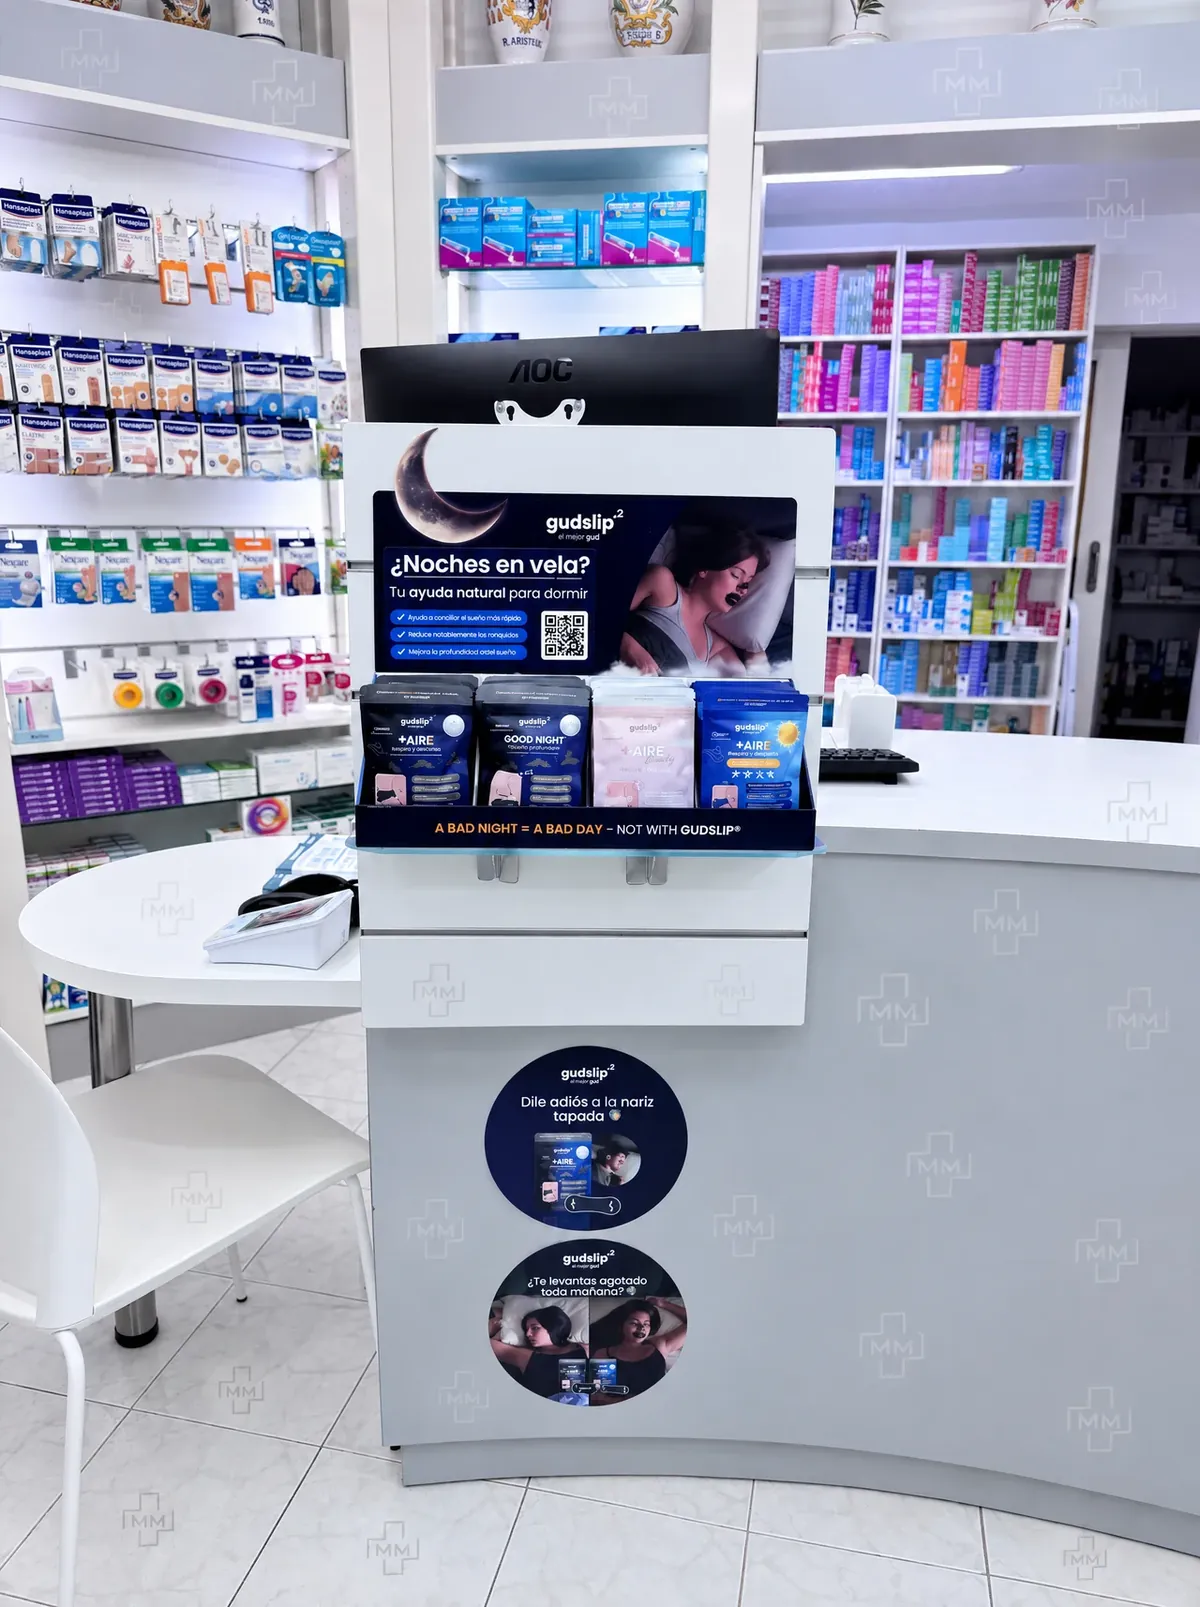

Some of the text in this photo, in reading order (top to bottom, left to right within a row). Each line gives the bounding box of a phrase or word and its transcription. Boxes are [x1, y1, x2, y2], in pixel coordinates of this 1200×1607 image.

[3, 202, 42, 214] Hansaplast
[55, 207, 93, 218] Hansaplast
[117, 217, 149, 228] Hansaplast
[15, 348, 52, 357] Hansaplast
[64, 351, 100, 361] Hansaplast
[109, 357, 144, 366] Hansaplast
[508, 357, 573, 383] AOC
[23, 418, 60, 428] Hansaplast
[71, 421, 106, 430] Hansaplast
[120, 422, 154, 430] Hansaplast
[566, 533, 584, 542] mejor
[586, 533, 600, 542] gud
[0, 557, 29, 567] Nexcare
[60, 554, 89, 564] Nexcare
[390, 554, 590, 577] ¿Noches en vela?
[389, 586, 588, 602] Tu ayuda natural para dormir
[408, 614, 428, 622] Ayuda
[408, 648, 431, 656] Mejora
[398, 735, 434, 746] +AIRE
[504, 735, 534, 744] GOOD
[736, 740, 771, 750] +AIRE
[435, 823, 444, 834] A
[447, 824, 475, 834] BAD
[478, 824, 518, 834] NIGHT
[533, 824, 543, 834] A
[546, 824, 574, 834] BAD
[576, 824, 603, 834] DAY
[617, 825, 643, 835] NOT
[647, 825, 677, 835] WITH
[521, 1096, 654, 1108] Dile adiós a la nariz
[554, 1110, 604, 1124] tapada
[527, 1276, 648, 1288] ¿Te levantas agotado
[541, 1286, 624, 1296] toda mañana?
